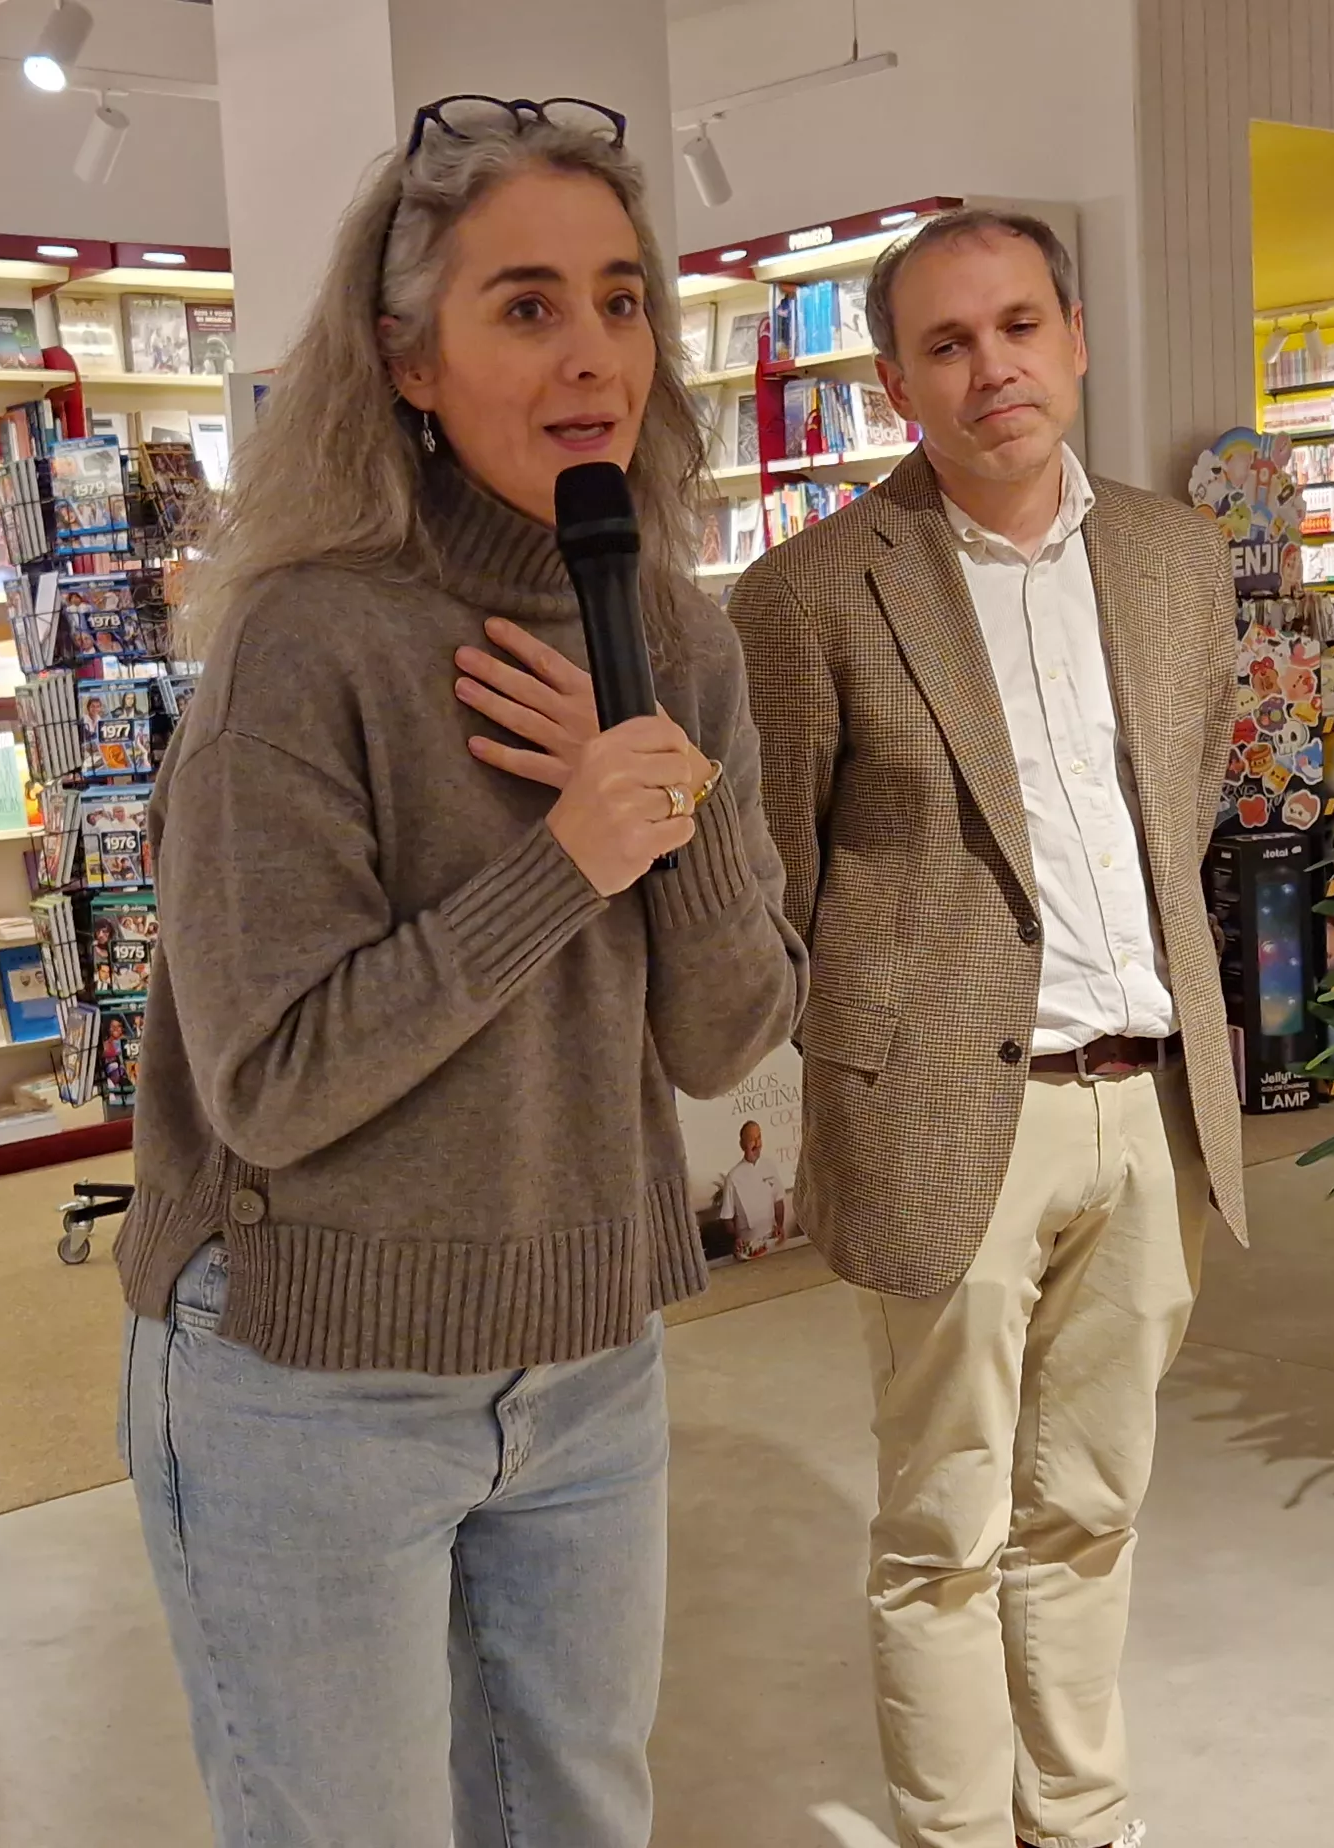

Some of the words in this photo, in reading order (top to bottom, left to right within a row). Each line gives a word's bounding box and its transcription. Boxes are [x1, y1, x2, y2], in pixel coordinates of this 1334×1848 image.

[73, 482, 105, 497] 1979
[1231, 543, 1279, 578] ENJI
[89, 615, 121, 628] 1978
[100, 724, 131, 738] 1977
[104, 836, 137, 850] 1976
[113, 946, 145, 959] 1975
[732, 1083, 801, 1116] ARGUIÑA
[1261, 1090, 1310, 1110] LAMP
